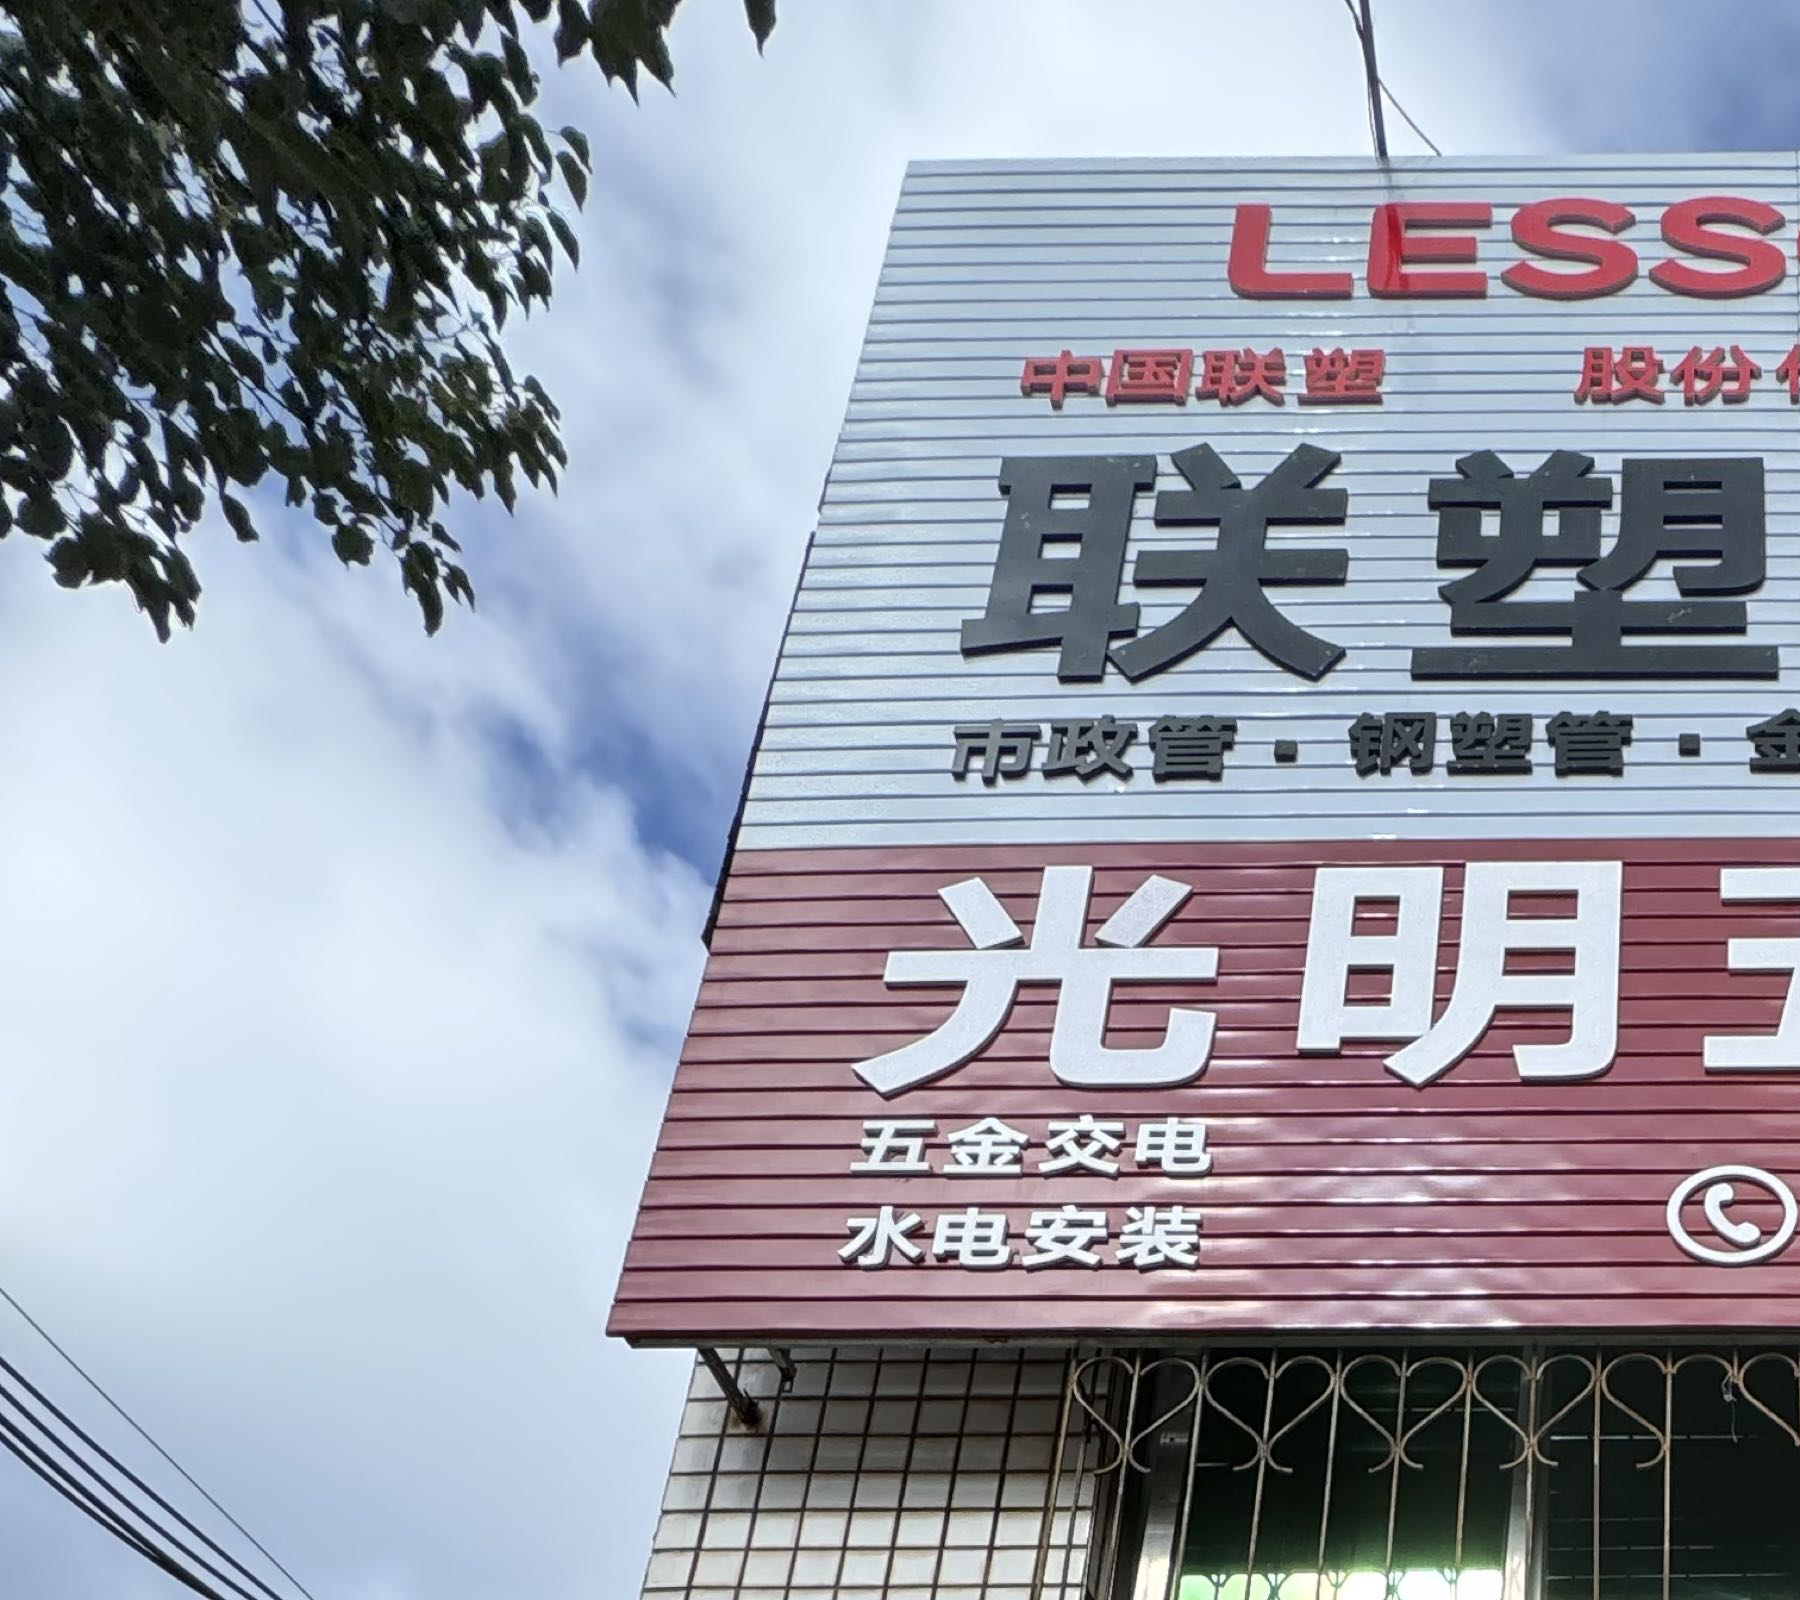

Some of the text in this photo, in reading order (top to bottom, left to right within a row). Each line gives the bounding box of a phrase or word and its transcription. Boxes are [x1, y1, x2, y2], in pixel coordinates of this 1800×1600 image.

[1018, 345, 1387, 408] 中国联塑
[850, 1117, 1213, 1180] 五金交电
[836, 1202, 1204, 1272] 水电安装
